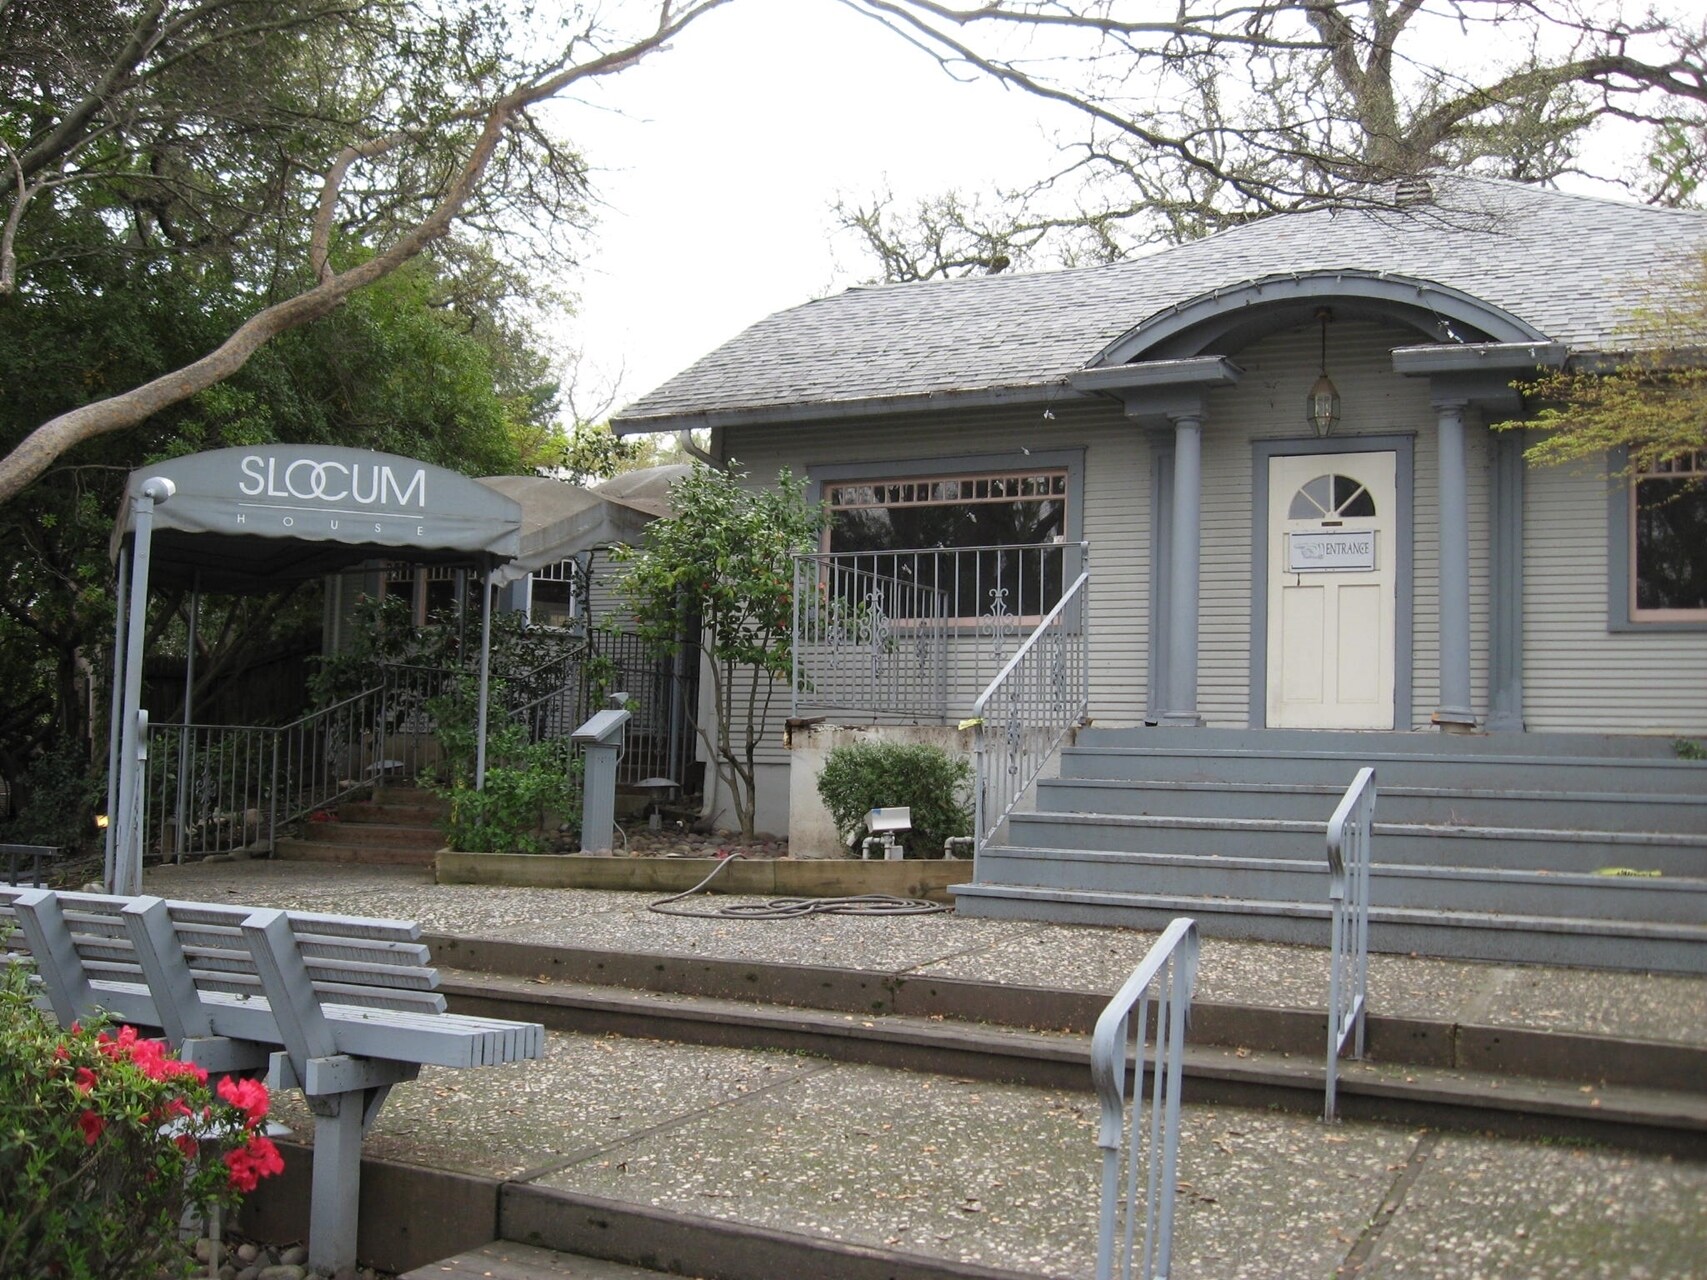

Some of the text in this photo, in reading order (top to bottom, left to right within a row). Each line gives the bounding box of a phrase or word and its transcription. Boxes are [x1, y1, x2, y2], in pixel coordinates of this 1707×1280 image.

[239, 455, 425, 507] SLOCUM
[236, 514, 423, 536] HOUSE
[1326, 542, 1369, 555] ENTRANCE
